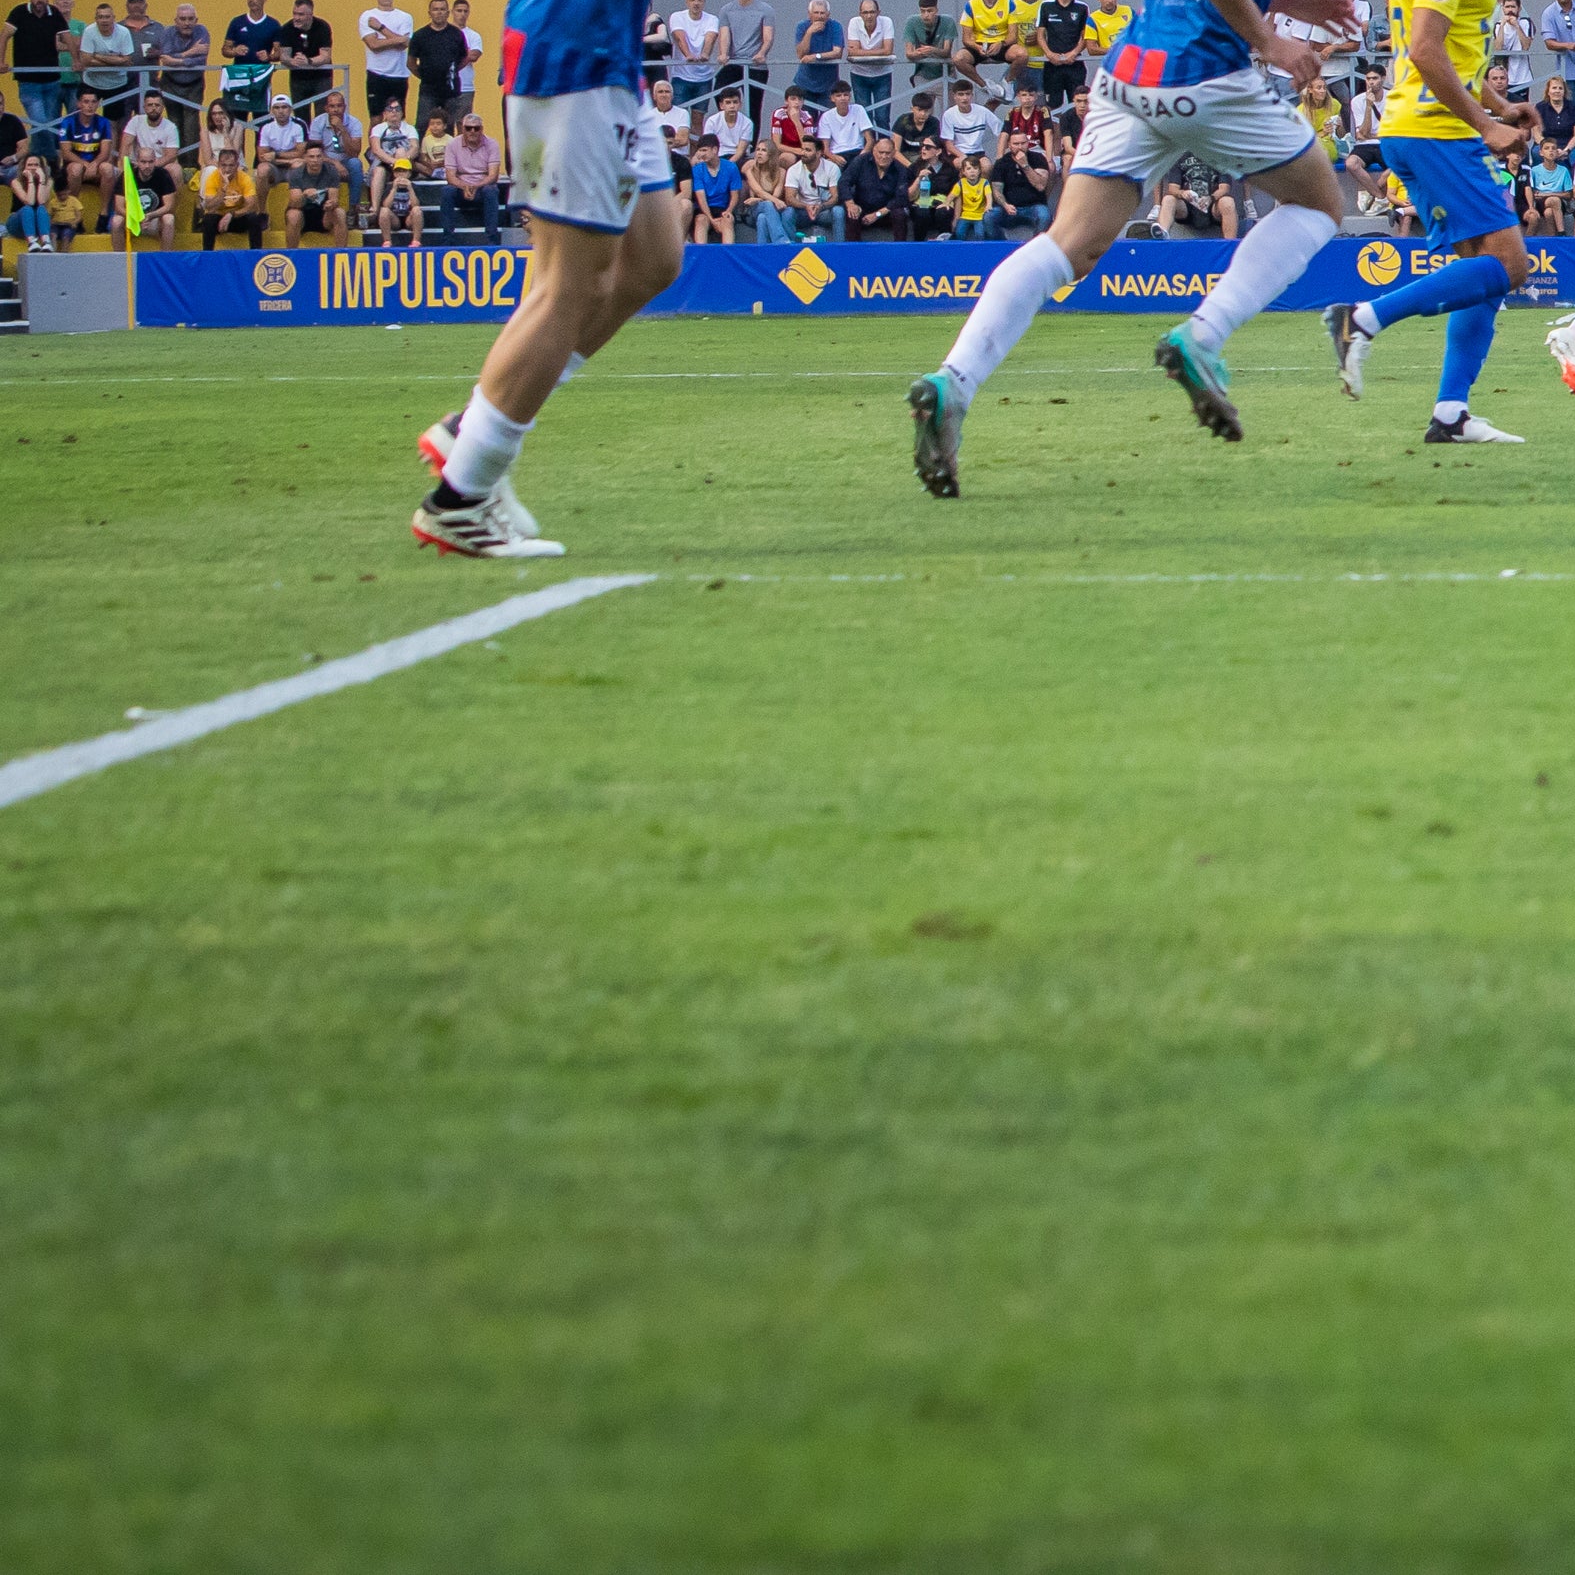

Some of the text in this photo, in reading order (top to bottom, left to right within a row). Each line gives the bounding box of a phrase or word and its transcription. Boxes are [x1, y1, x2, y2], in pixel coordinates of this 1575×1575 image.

[849, 276, 983, 299] NAVASAEZ
[1101, 273, 1222, 297] NAVASAE
[259, 300, 293, 312] TERCERA
